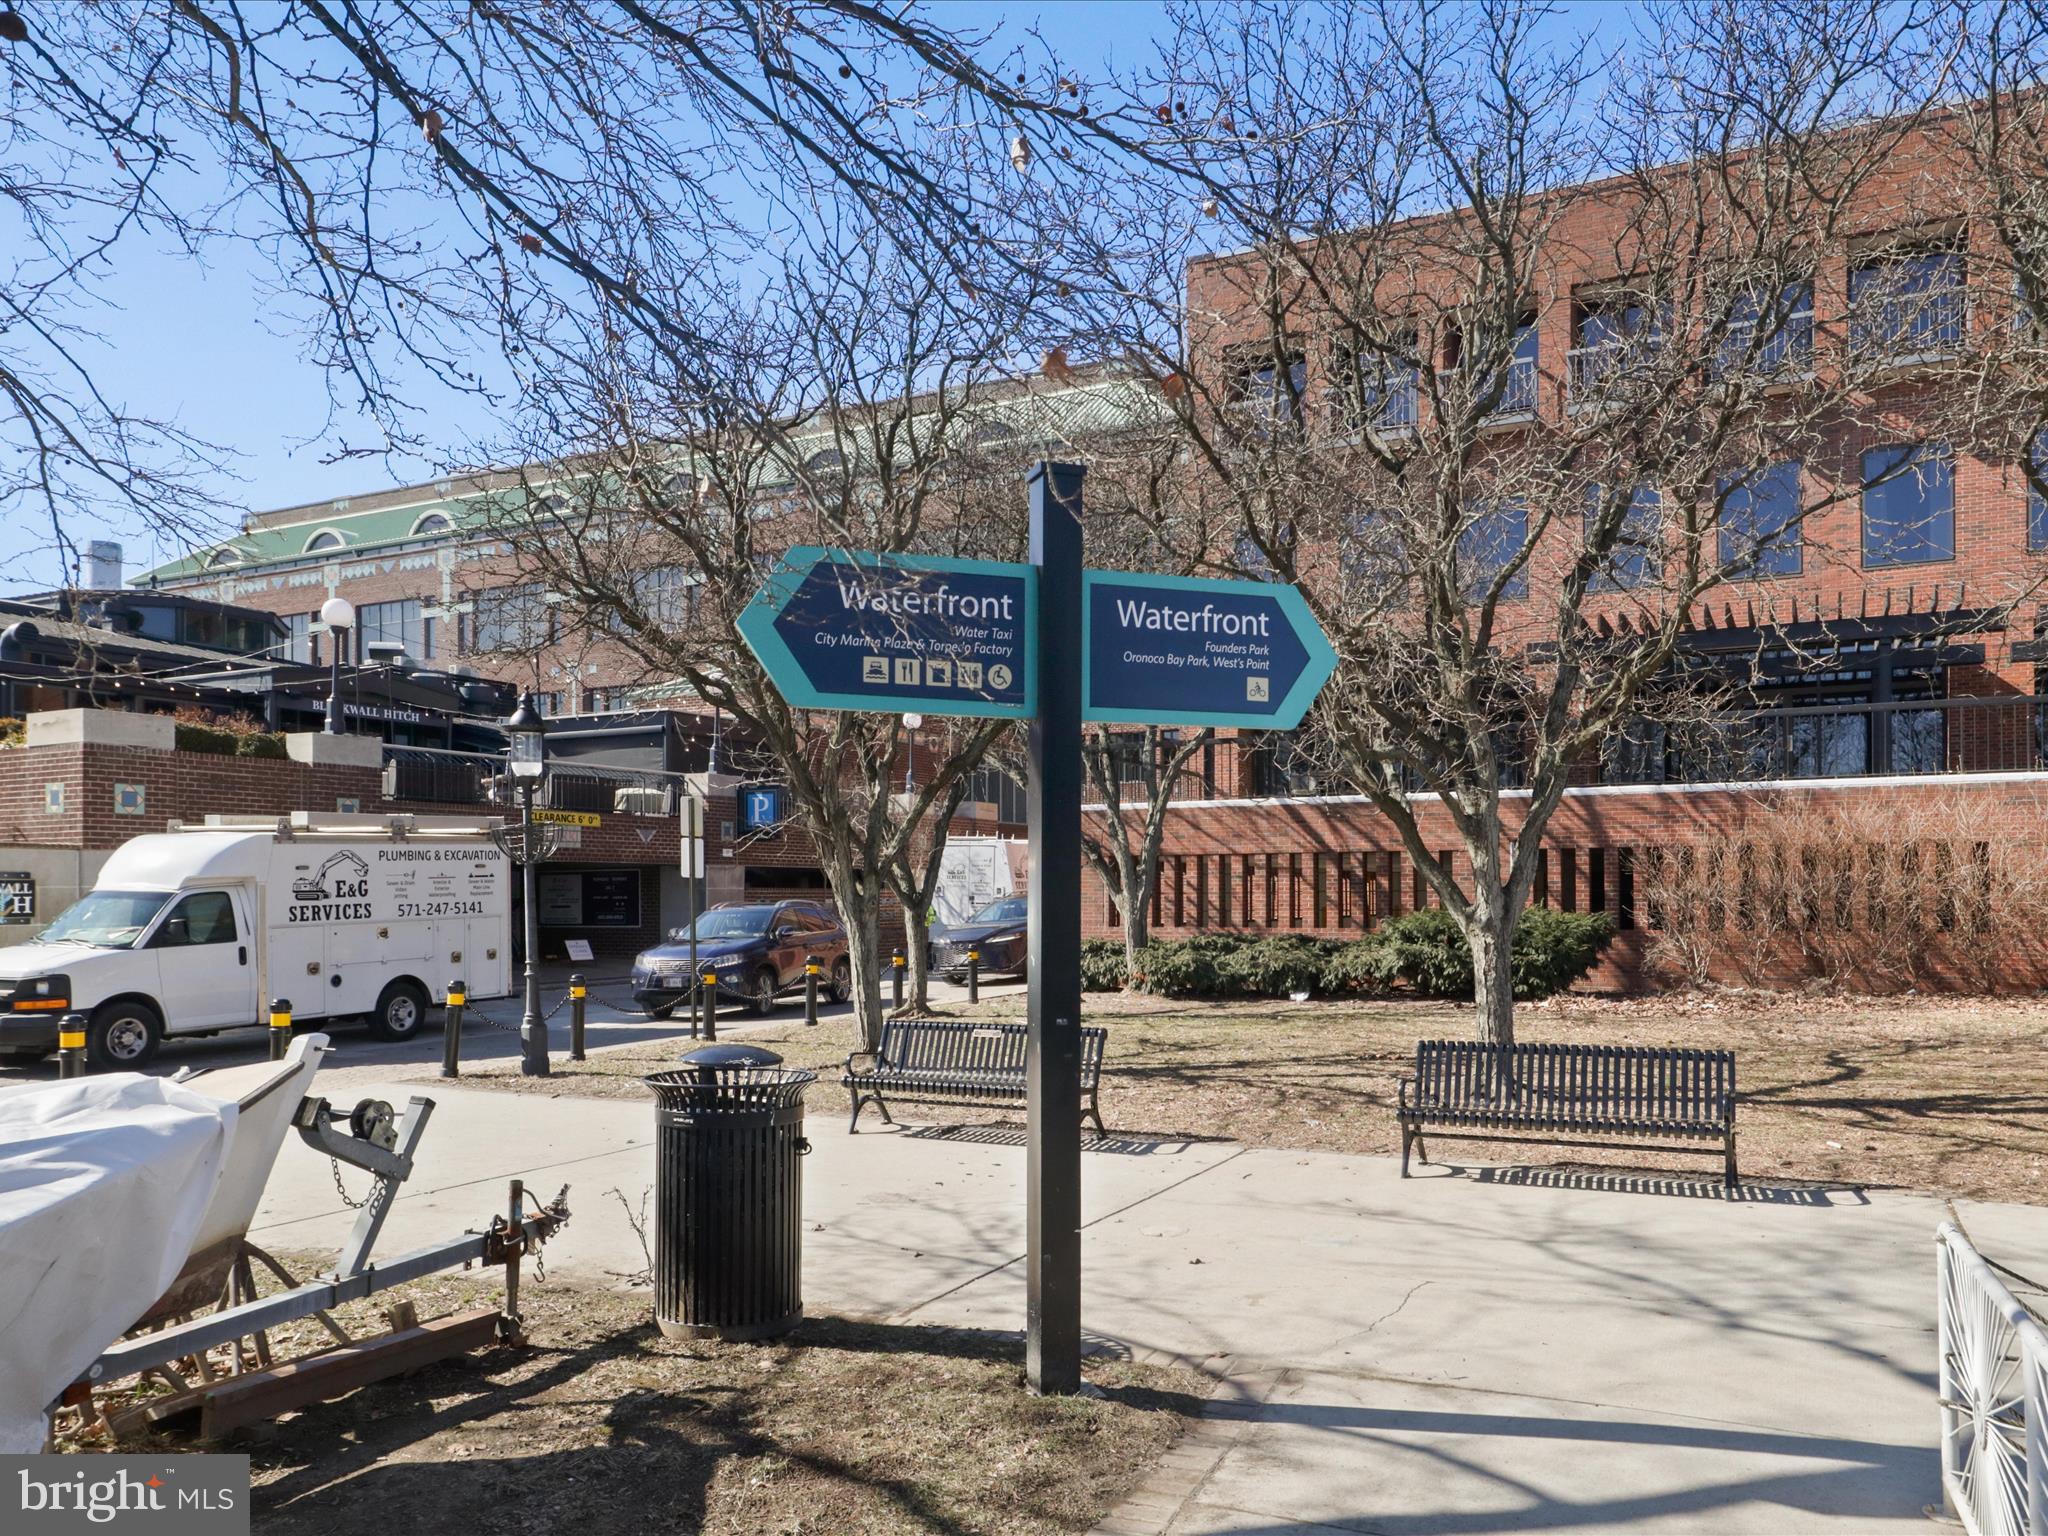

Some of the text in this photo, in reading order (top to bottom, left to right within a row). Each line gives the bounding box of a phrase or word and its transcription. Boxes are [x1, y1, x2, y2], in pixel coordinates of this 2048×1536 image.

[839, 580, 1013, 621] Waterfront
[1117, 599, 1269, 637] Waterfront
[954, 625, 1013, 640] Water Taxi
[814, 632, 1013, 658] City Marina Plaza & Torpedo Factory
[1205, 641, 1269, 656] Founders Park
[1123, 651, 1270, 671] Oronoco Bay Park, West's Point
[312, 700, 420, 723] BLKWALL HITCH
[531, 811, 576, 824] CLEARANCE
[752, 796, 769, 823] P
[378, 849, 501, 862] PLUMBING & EXCAVATION
[335, 880, 369, 898] E&G
[288, 903, 372, 922] SERVICES
[397, 901, 484, 917] 571-247-5141
